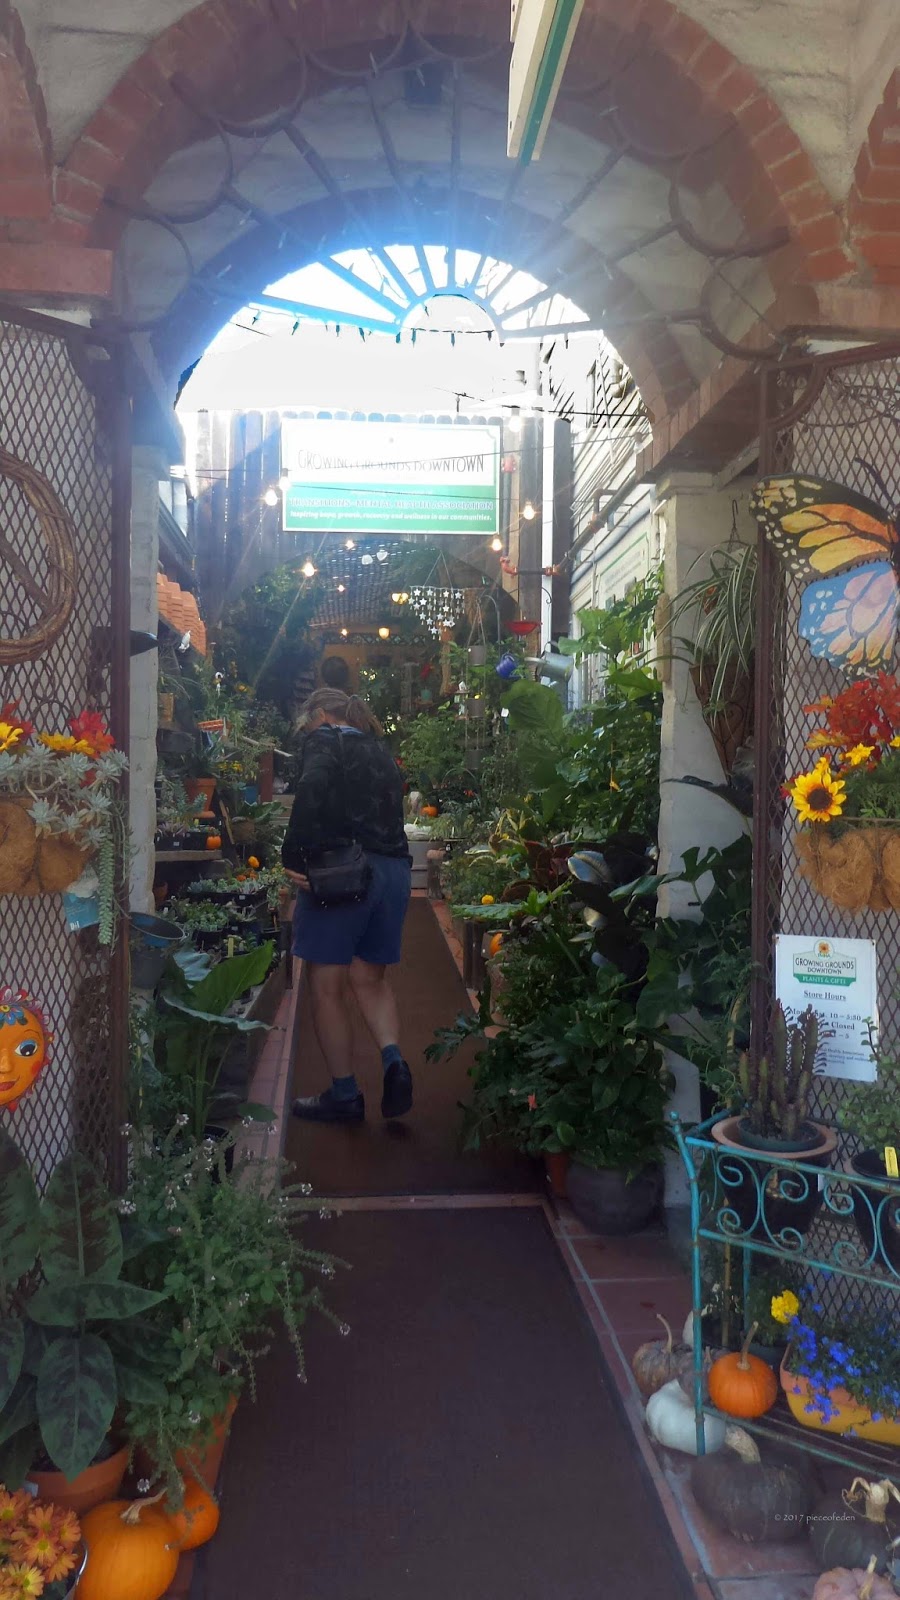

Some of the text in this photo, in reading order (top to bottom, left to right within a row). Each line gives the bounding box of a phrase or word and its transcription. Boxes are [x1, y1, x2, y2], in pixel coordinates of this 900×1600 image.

[414, 453, 485, 473] DOWNTOWN
[432, 501, 493, 511] ASSOCIATION
[795, 957, 854, 970] GROWING GROUNDS
[807, 966, 842, 975] DOWNTOWN
[802, 975, 824, 983] PLANTS
[830, 977, 846, 985] GIFTS
[803, 990, 847, 1001] Store Hours
[831, 1022, 855, 1031] Closed
